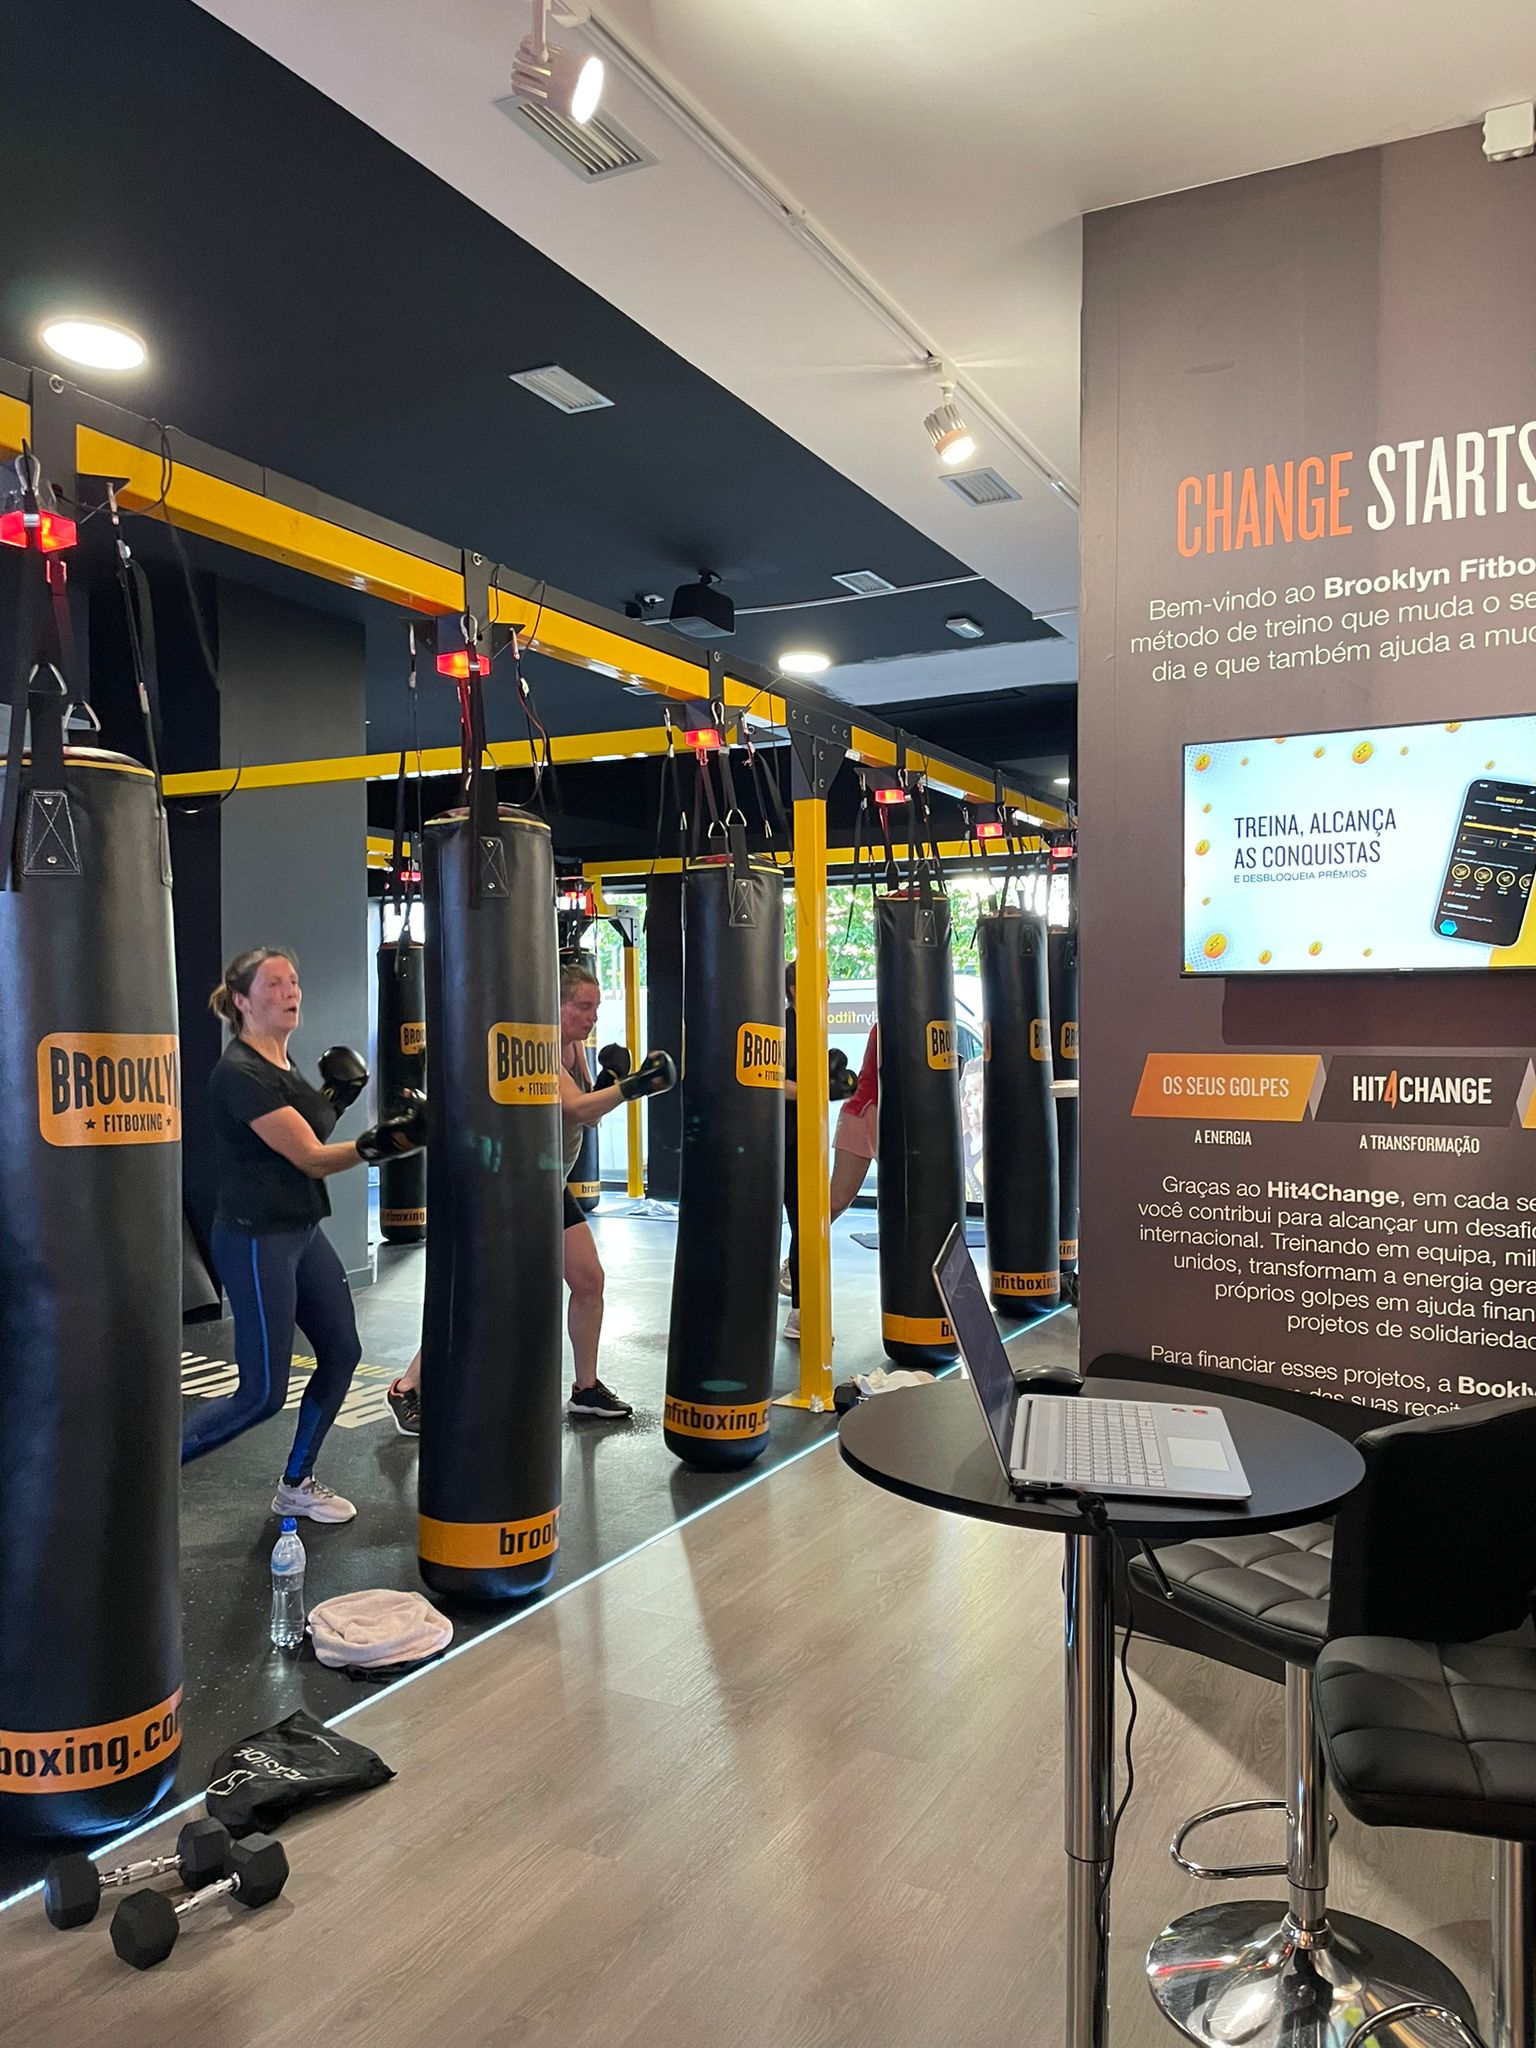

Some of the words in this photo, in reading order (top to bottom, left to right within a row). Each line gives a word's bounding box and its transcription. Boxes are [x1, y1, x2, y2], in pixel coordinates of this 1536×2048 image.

[1177, 451, 1354, 557] CHANGE
[1367, 420, 1536, 531] STARTS
[1150, 587, 1277, 620] Bem-vindo
[1285, 585, 1315, 604] ao
[1324, 567, 1449, 599] Brooklyn
[1460, 556, 1536, 582] Fitbo
[1131, 625, 1219, 653] método
[1227, 621, 1257, 642] de
[1265, 614, 1333, 638] treino
[1341, 608, 1390, 634] que
[1398, 595, 1474, 623] muda
[1483, 595, 1500, 614] o
[1509, 591, 1536, 611] se
[1152, 660, 1186, 682] dia
[1193, 661, 1208, 677] e
[1215, 655, 1260, 679] que
[1267, 641, 1370, 670] também
[1379, 632, 1450, 662] ajuda
[1459, 632, 1475, 650] a
[1234, 814, 1304, 838] TREINA,
[1310, 808, 1397, 837] ALCANÇA
[1234, 847, 1257, 869] AS
[1262, 840, 1381, 868] CONQUISTAS
[1234, 874, 1240, 883] E
[1243, 872, 1315, 883] DESBLOQUEIA
[1163, 1076, 1182, 1095] OS
[1186, 1076, 1225, 1096] SEUS
[1229, 1077, 1289, 1097] GOLPES
[1352, 1070, 1493, 1109] HIT4CHANGE
[104, 1113, 163, 1133] FITBOXING
[1194, 1129, 1202, 1143] A
[1204, 1130, 1252, 1145] ENERGIA
[1359, 1134, 1368, 1150] A
[1370, 1134, 1480, 1157] TRANSFORMAÇÃO
[1162, 1175, 1230, 1198] Graças
[1236, 1183, 1260, 1197] ao
[1267, 1180, 1405, 1208] Hit4Change,
[1413, 1192, 1446, 1207] em
[1454, 1191, 1509, 1210] cada
[1138, 1201, 1183, 1218] você
[1188, 1205, 1271, 1223] contribui
[1278, 1210, 1322, 1228] para
[1328, 1211, 1417, 1235] alcançar
[1424, 1219, 1458, 1235] um
[1140, 1224, 1264, 1248] internacional.
[1271, 1232, 1370, 1256] Treinando
[1376, 1243, 1409, 1258] em
[1416, 1244, 1496, 1267] equipa,
[1174, 1253, 1241, 1275] unidos,
[1248, 1257, 1377, 1283] transformam
[1383, 1270, 1397, 1284] a
[1403, 1271, 1483, 1294] energia
[1215, 1281, 1295, 1304] próprios
[1301, 1288, 1370, 1310] golpes
[1376, 1296, 1409, 1312] em
[1416, 1297, 1476, 1318] ajuda
[1482, 1300, 1535, 1322] finan
[1288, 1314, 1369, 1335] projetos
[1376, 1320, 1403, 1338] de
[1151, 1344, 1192, 1365] Para
[1197, 1350, 1276, 1374] financiar
[1281, 1362, 1338, 1380] esses
[1343, 1367, 1431, 1393] projetos,
[1438, 1378, 1452, 1393] a
